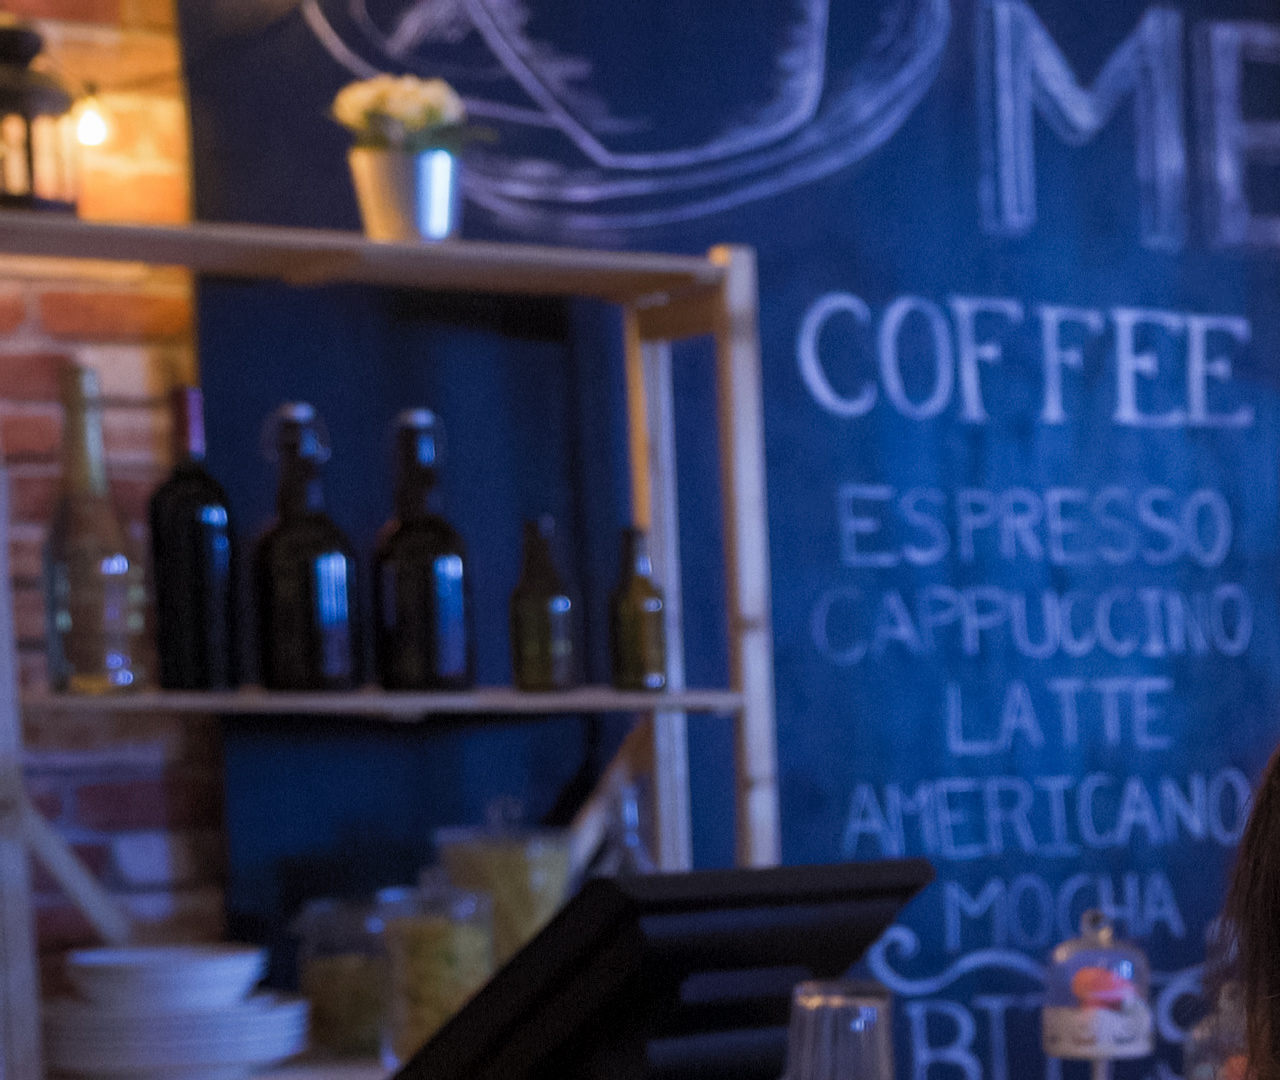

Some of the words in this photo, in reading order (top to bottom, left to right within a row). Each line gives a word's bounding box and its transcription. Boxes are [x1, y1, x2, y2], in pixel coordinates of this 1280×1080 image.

[799, 291, 1253, 427] COFFEE
[839, 483, 1232, 567] ESPRESSO
[811, 585, 1253, 666] CAPPUCCINO
[945, 677, 1174, 757] LATTE
[840, 767, 1253, 859] AMERICANO
[943, 870, 1186, 952] MOCHA
